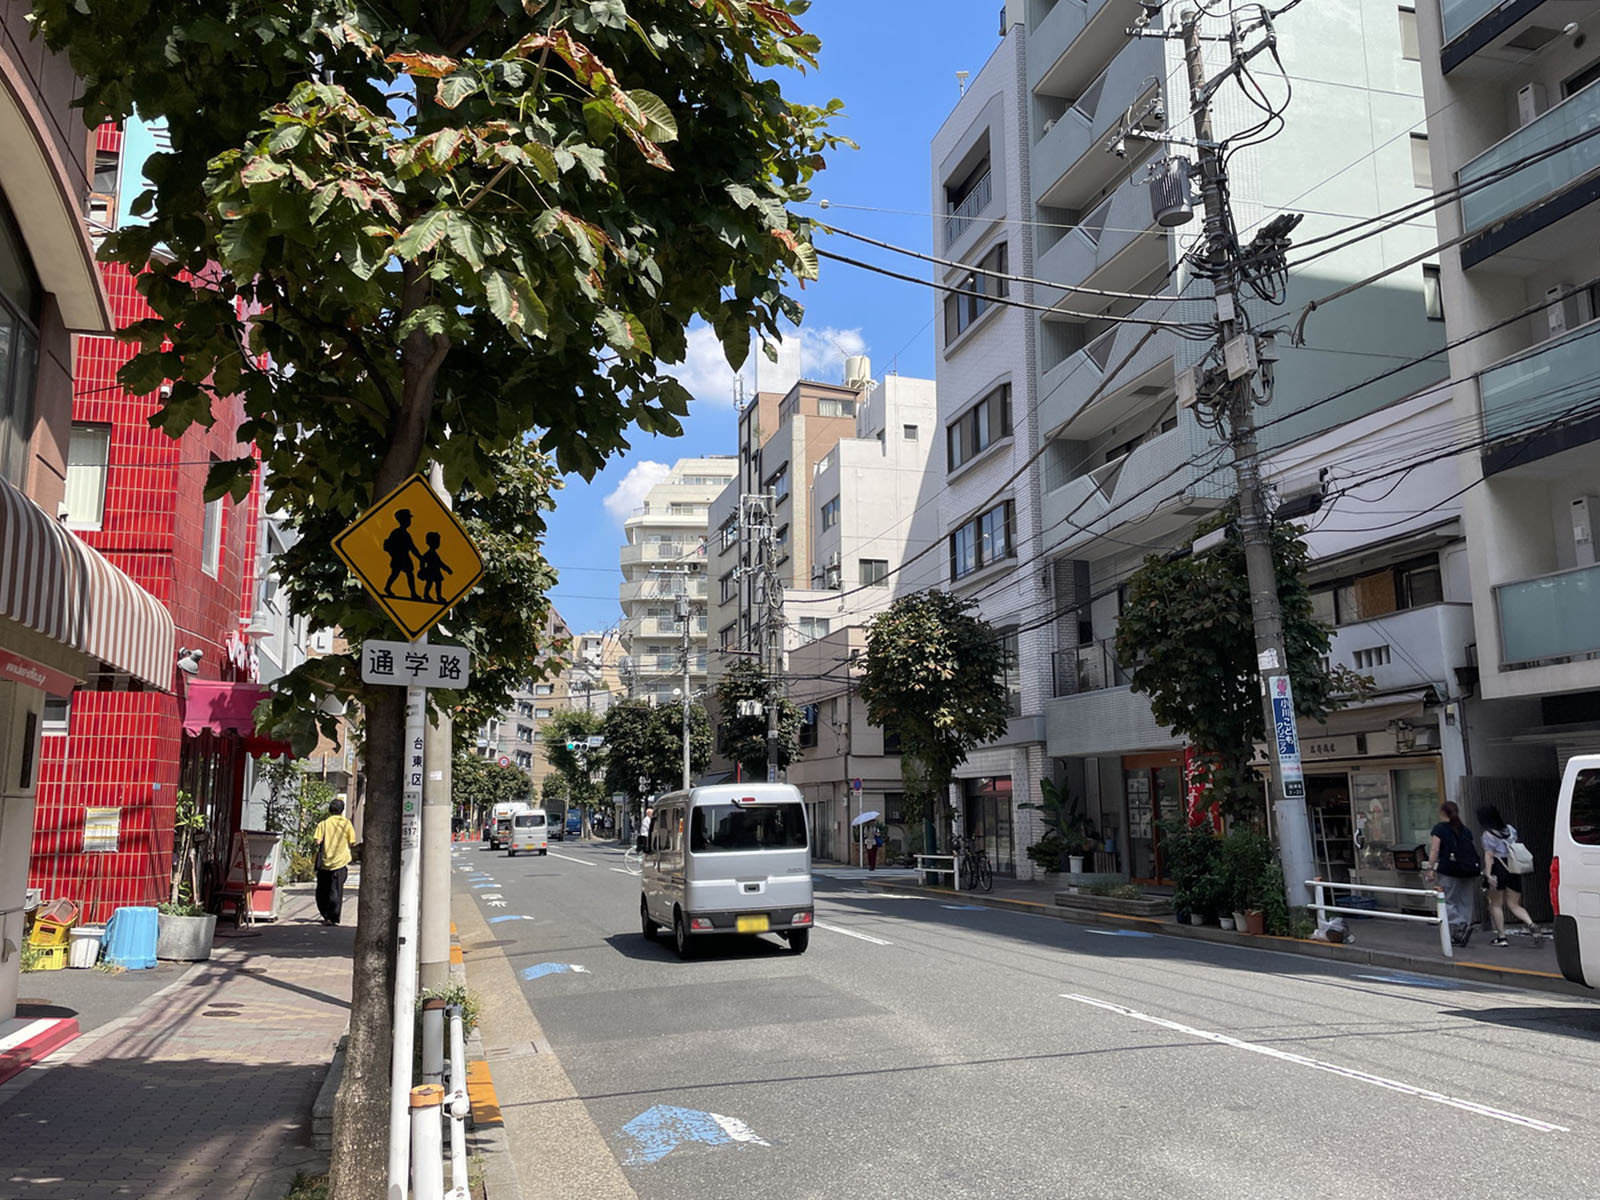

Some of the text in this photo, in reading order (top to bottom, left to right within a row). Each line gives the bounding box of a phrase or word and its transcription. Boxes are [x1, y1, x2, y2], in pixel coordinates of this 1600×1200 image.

[369, 649, 463, 680] 通学路
[1276, 722, 1287, 754] クリニック
[1280, 699, 1294, 745] 小川こども
[411, 736, 424, 786] 台東区
